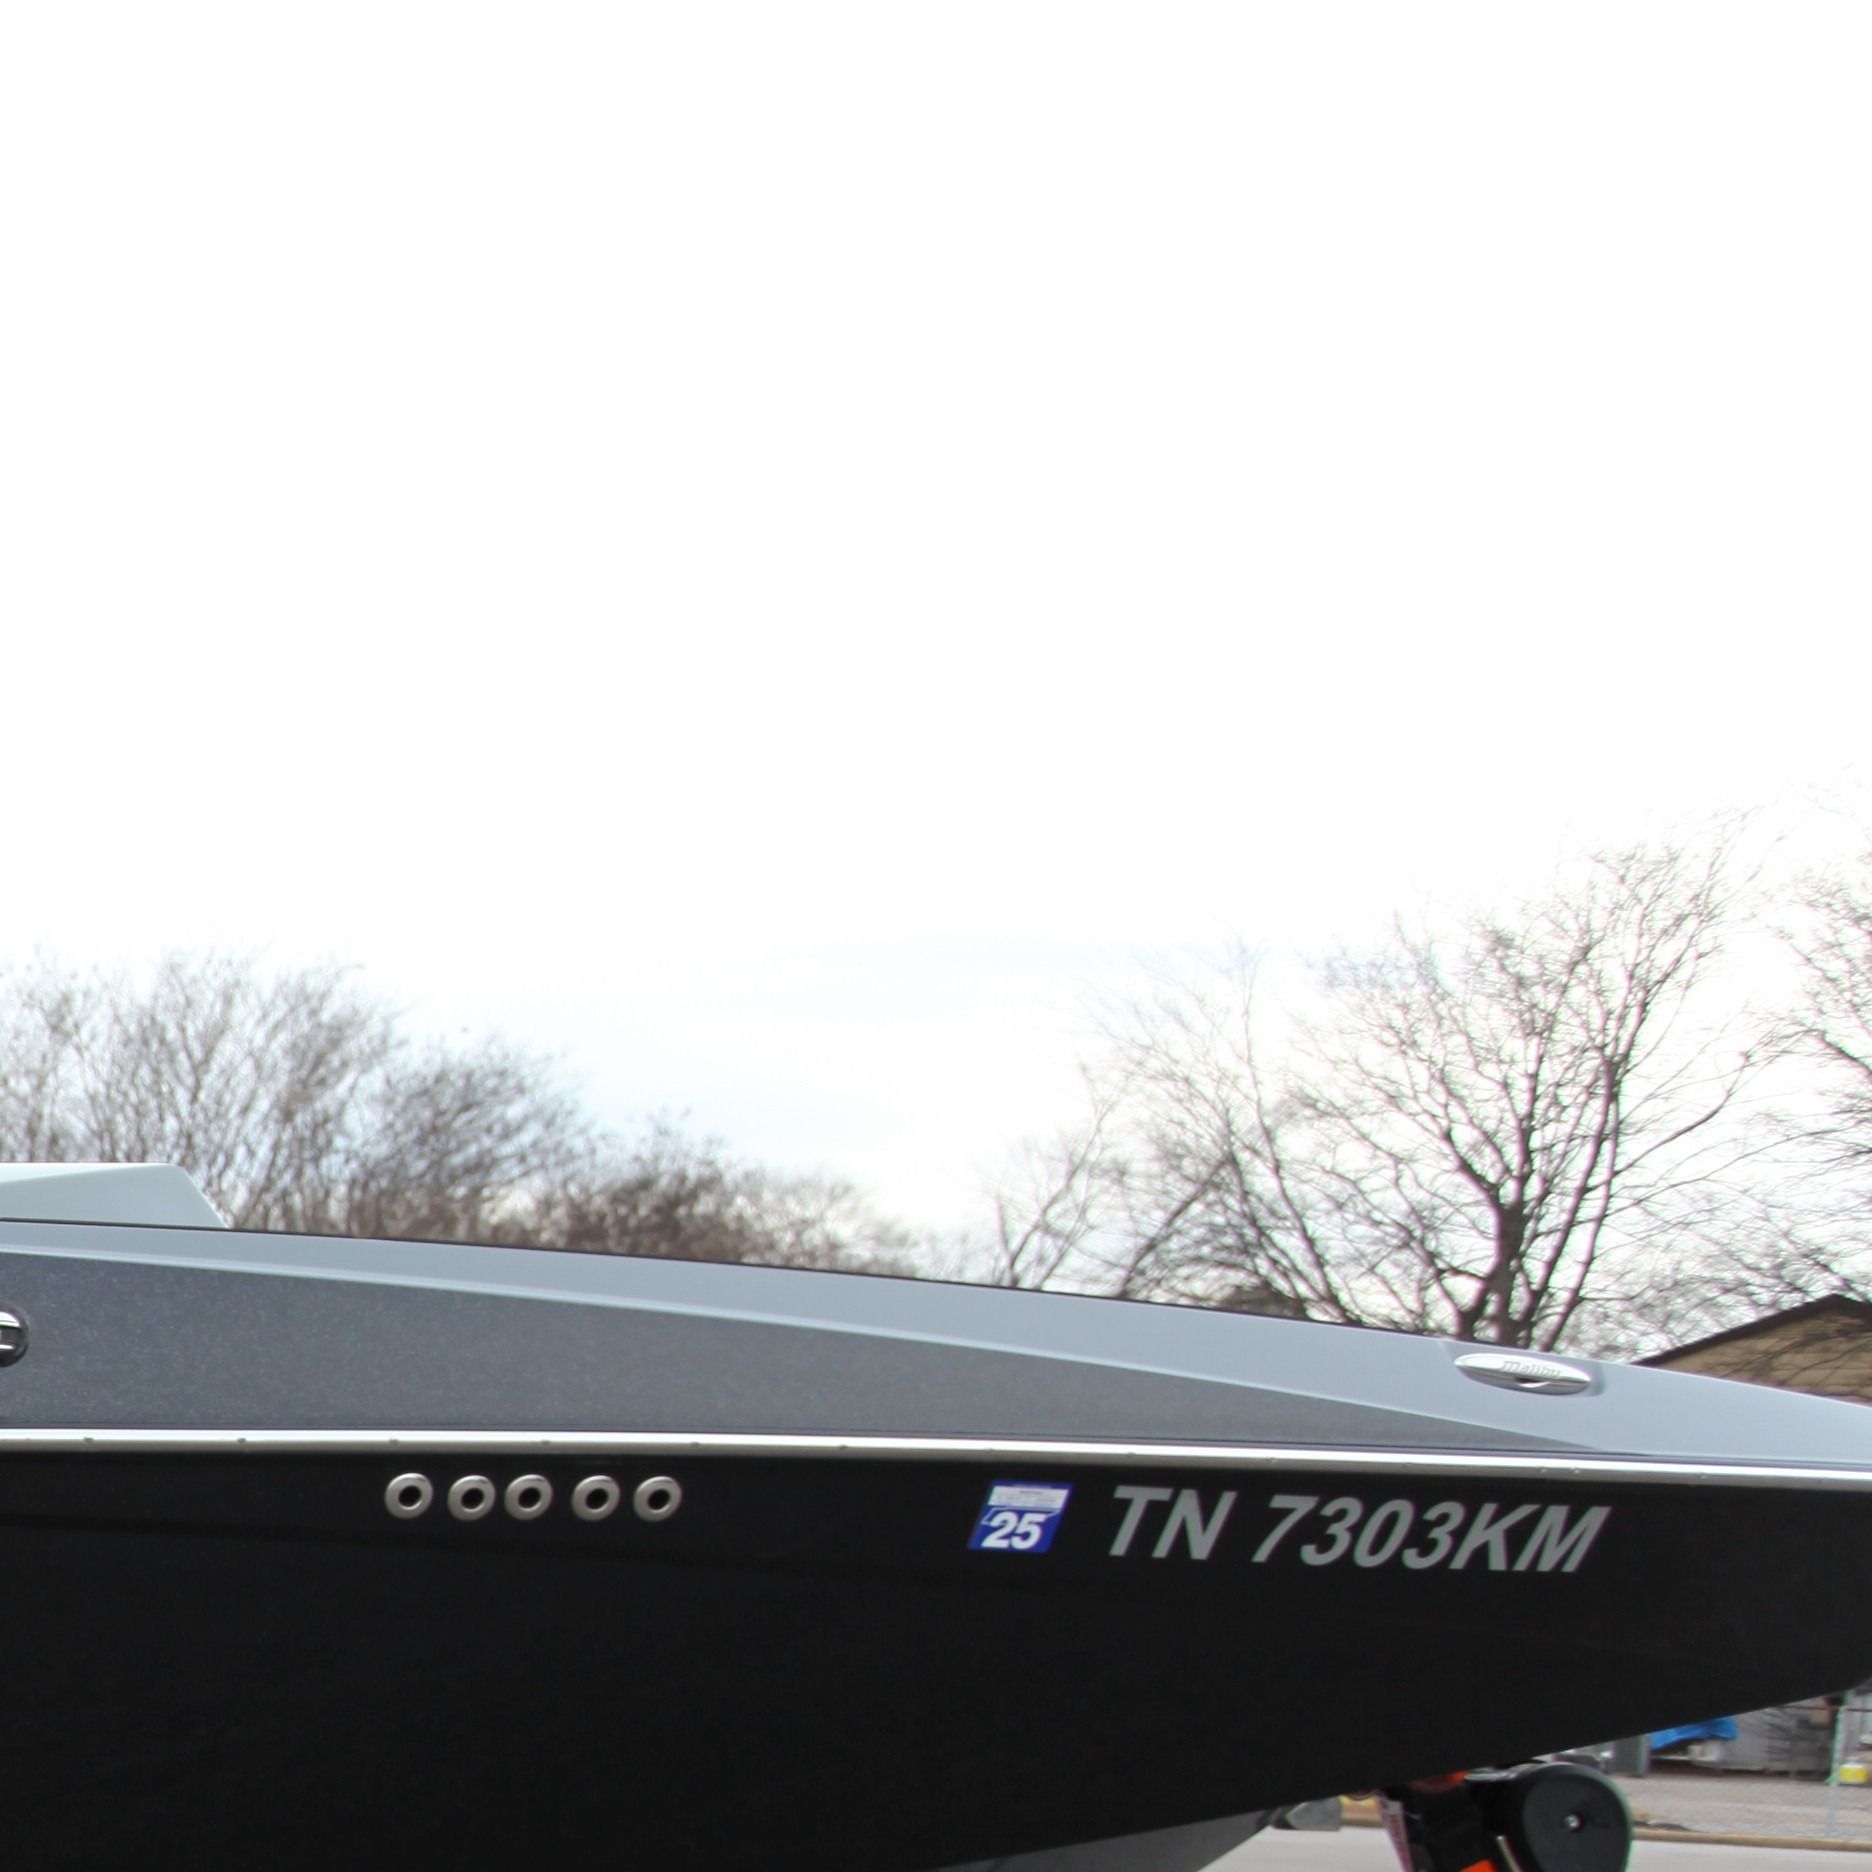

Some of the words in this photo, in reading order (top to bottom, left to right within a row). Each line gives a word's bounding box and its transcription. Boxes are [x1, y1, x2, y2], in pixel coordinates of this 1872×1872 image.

[980, 1511, 1042, 1550] 25
[1108, 1485, 1237, 1560] TN
[1252, 1494, 1612, 1573] 7303KM
